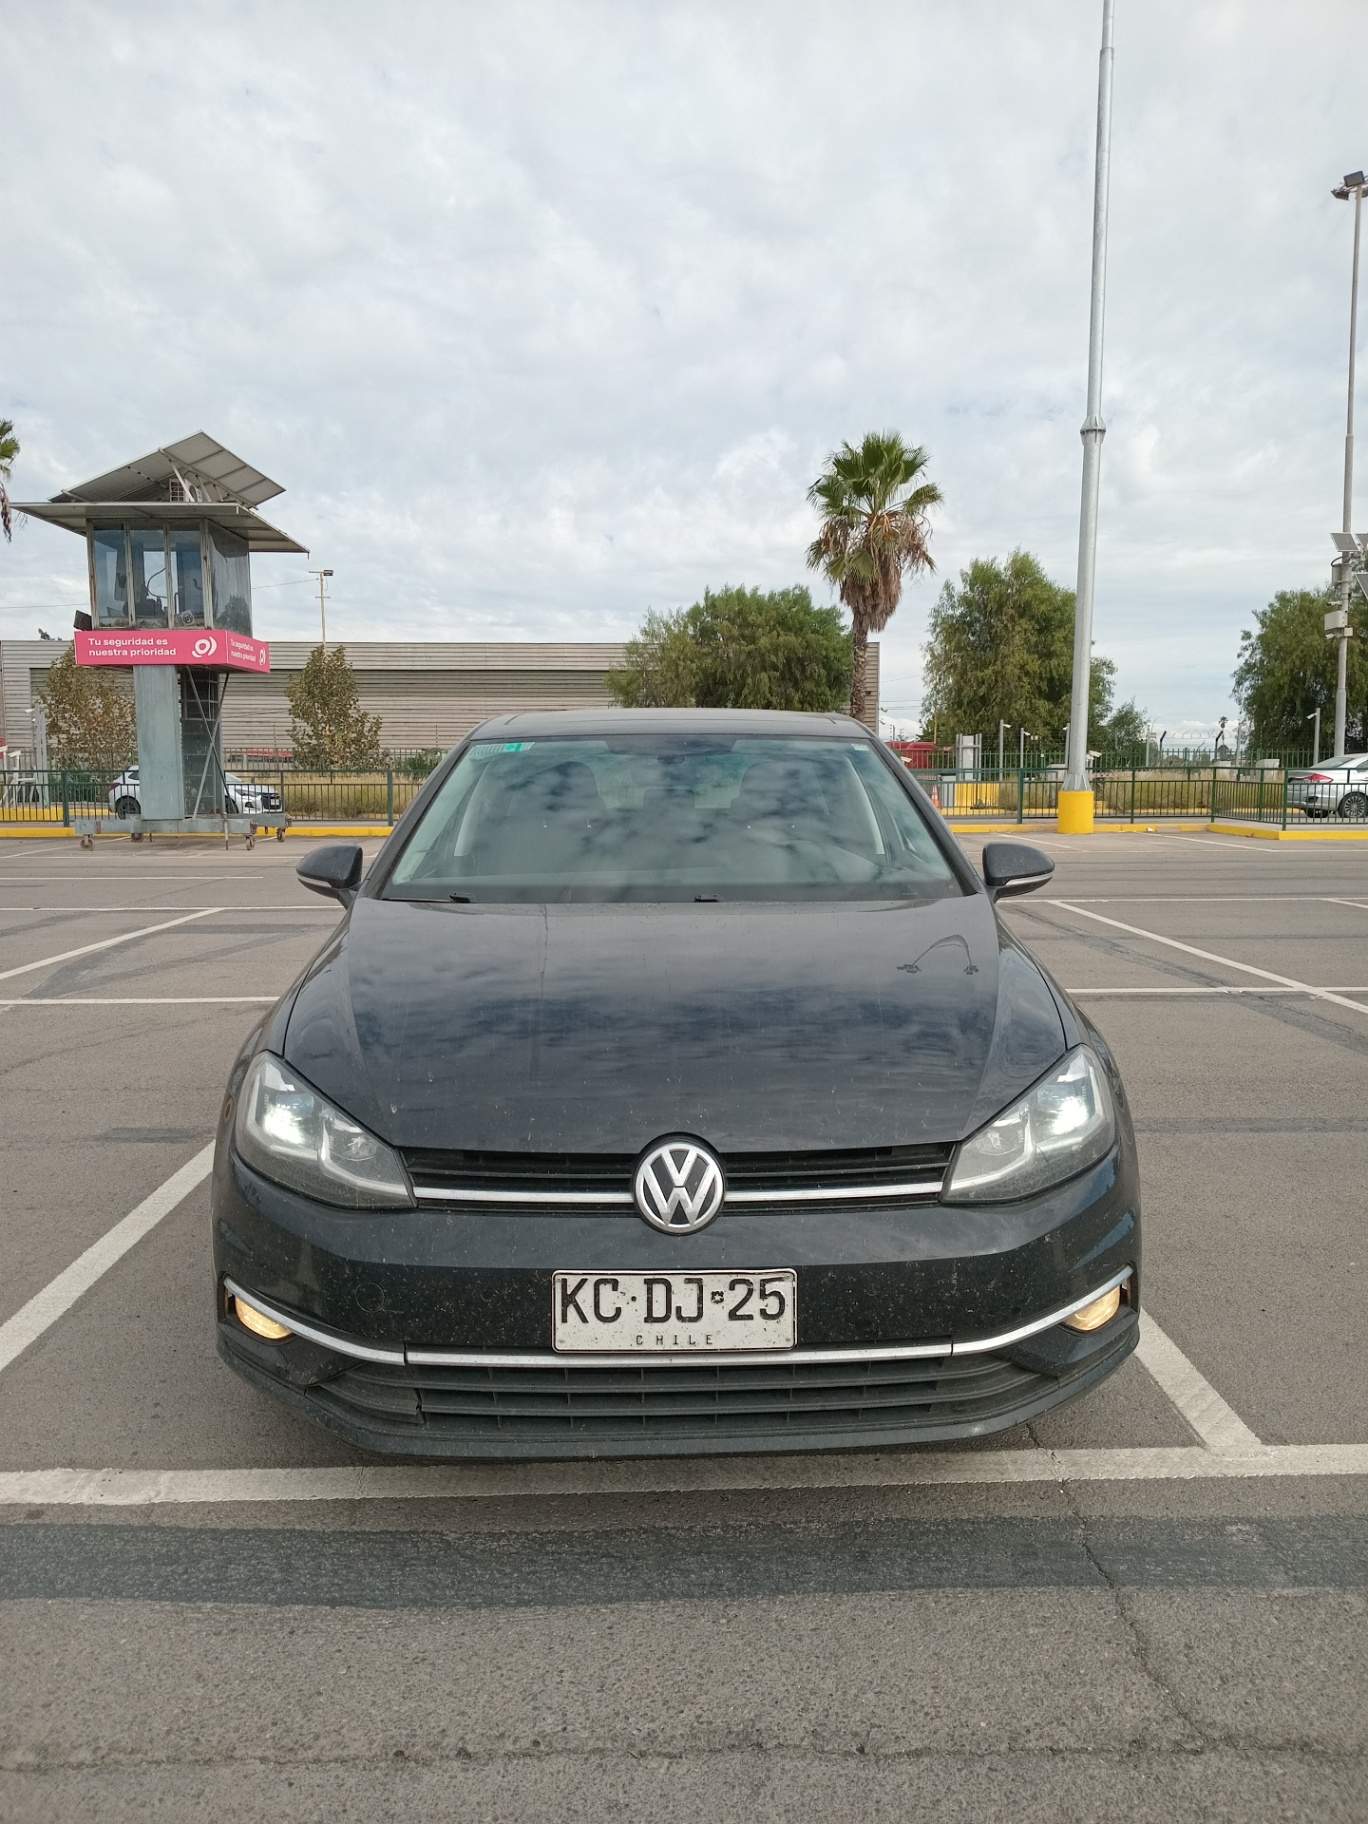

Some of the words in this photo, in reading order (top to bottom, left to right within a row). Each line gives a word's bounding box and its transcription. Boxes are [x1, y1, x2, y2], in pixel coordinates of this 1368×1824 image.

[88, 638, 101, 646] Tu
[103, 637, 154, 647] seguridad
[156, 638, 168, 646] es
[88, 648, 128, 657] nuestra
[130, 648, 177, 658] prioridad
[636, 1334, 713, 1346] CHILE
